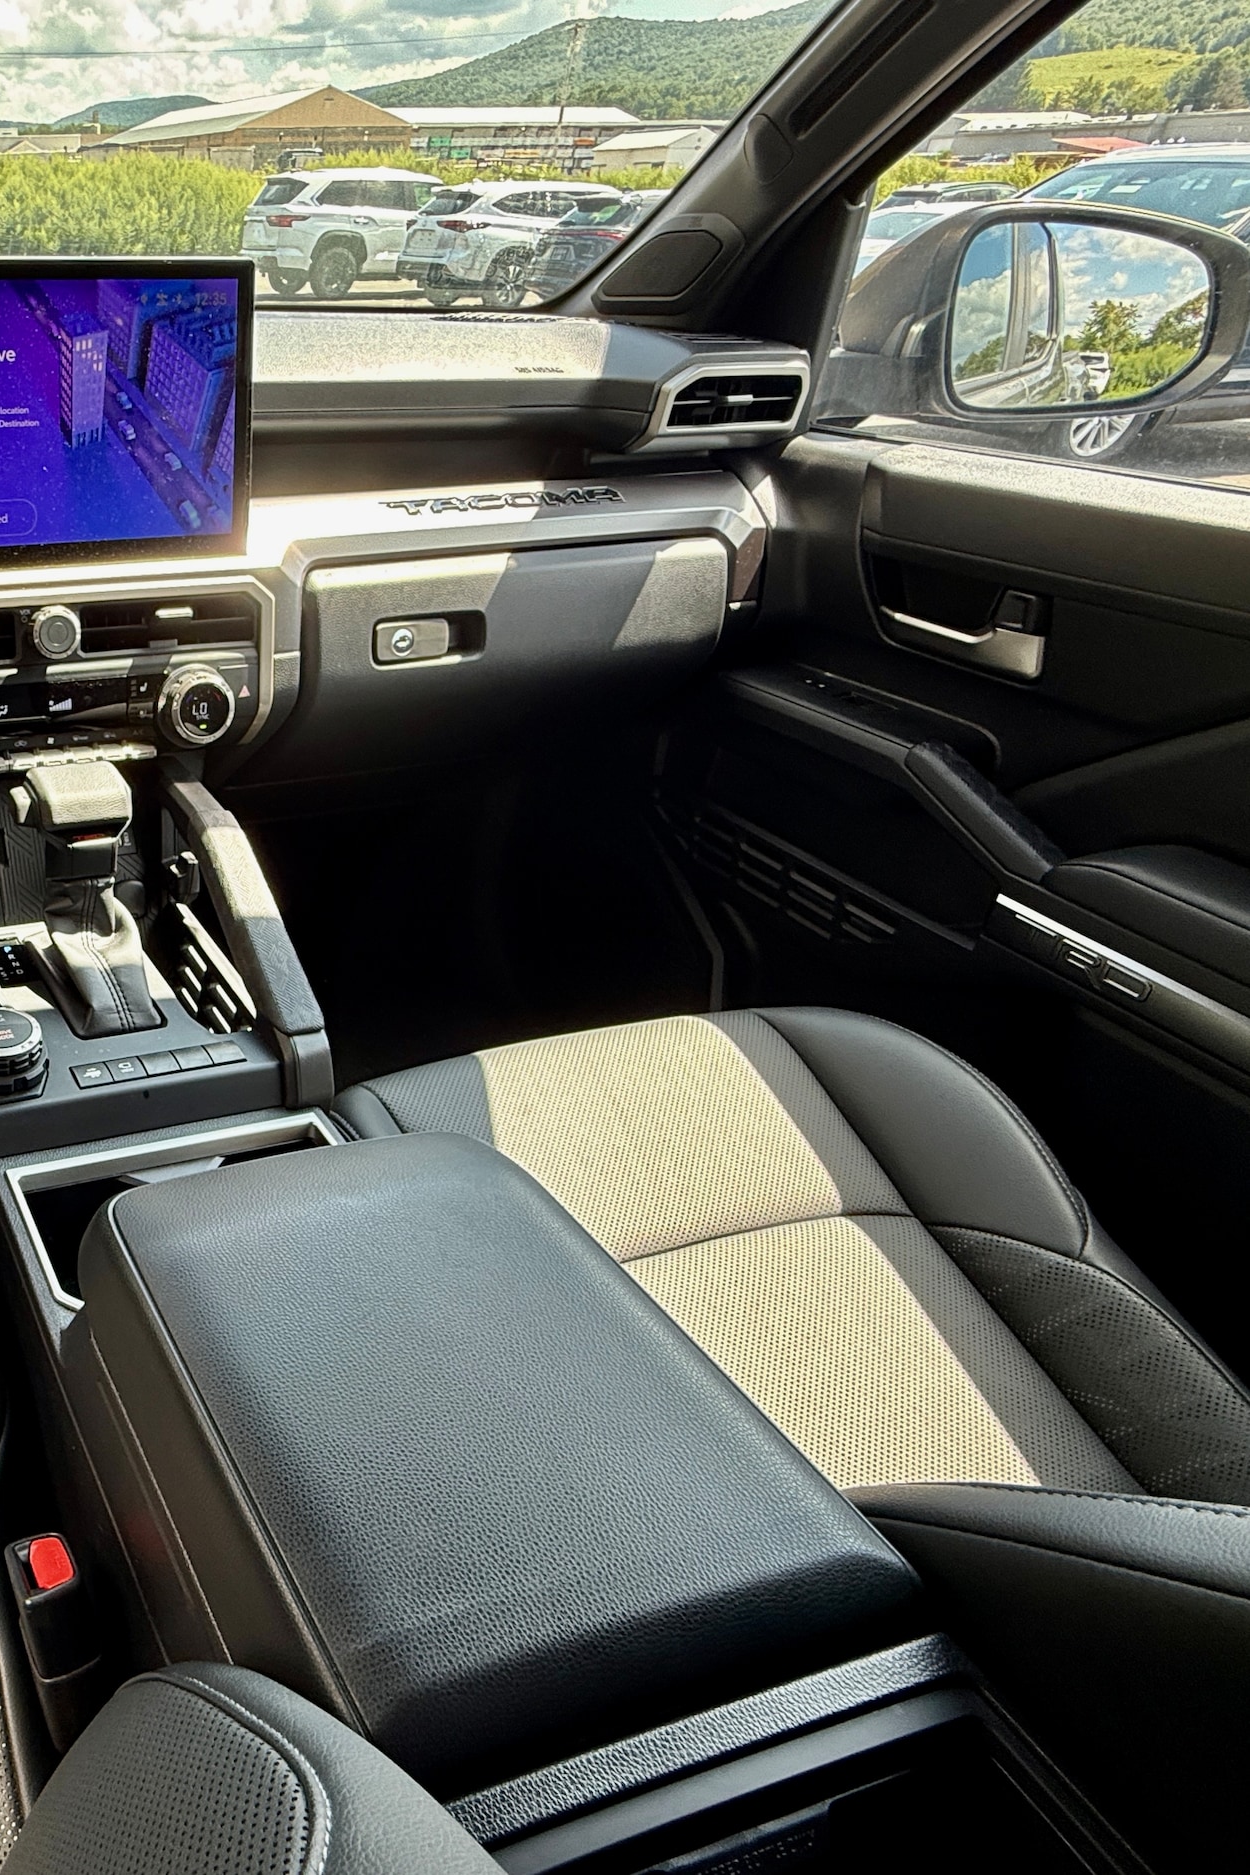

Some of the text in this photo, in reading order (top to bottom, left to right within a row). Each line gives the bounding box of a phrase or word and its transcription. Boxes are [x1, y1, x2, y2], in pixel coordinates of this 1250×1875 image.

[195, 292, 227, 306] 12:35
[0, 406, 30, 415] location
[378, 485, 626, 516] TACOMA
[192, 702, 208, 716] LO
[1015, 913, 1153, 1001] TRD
